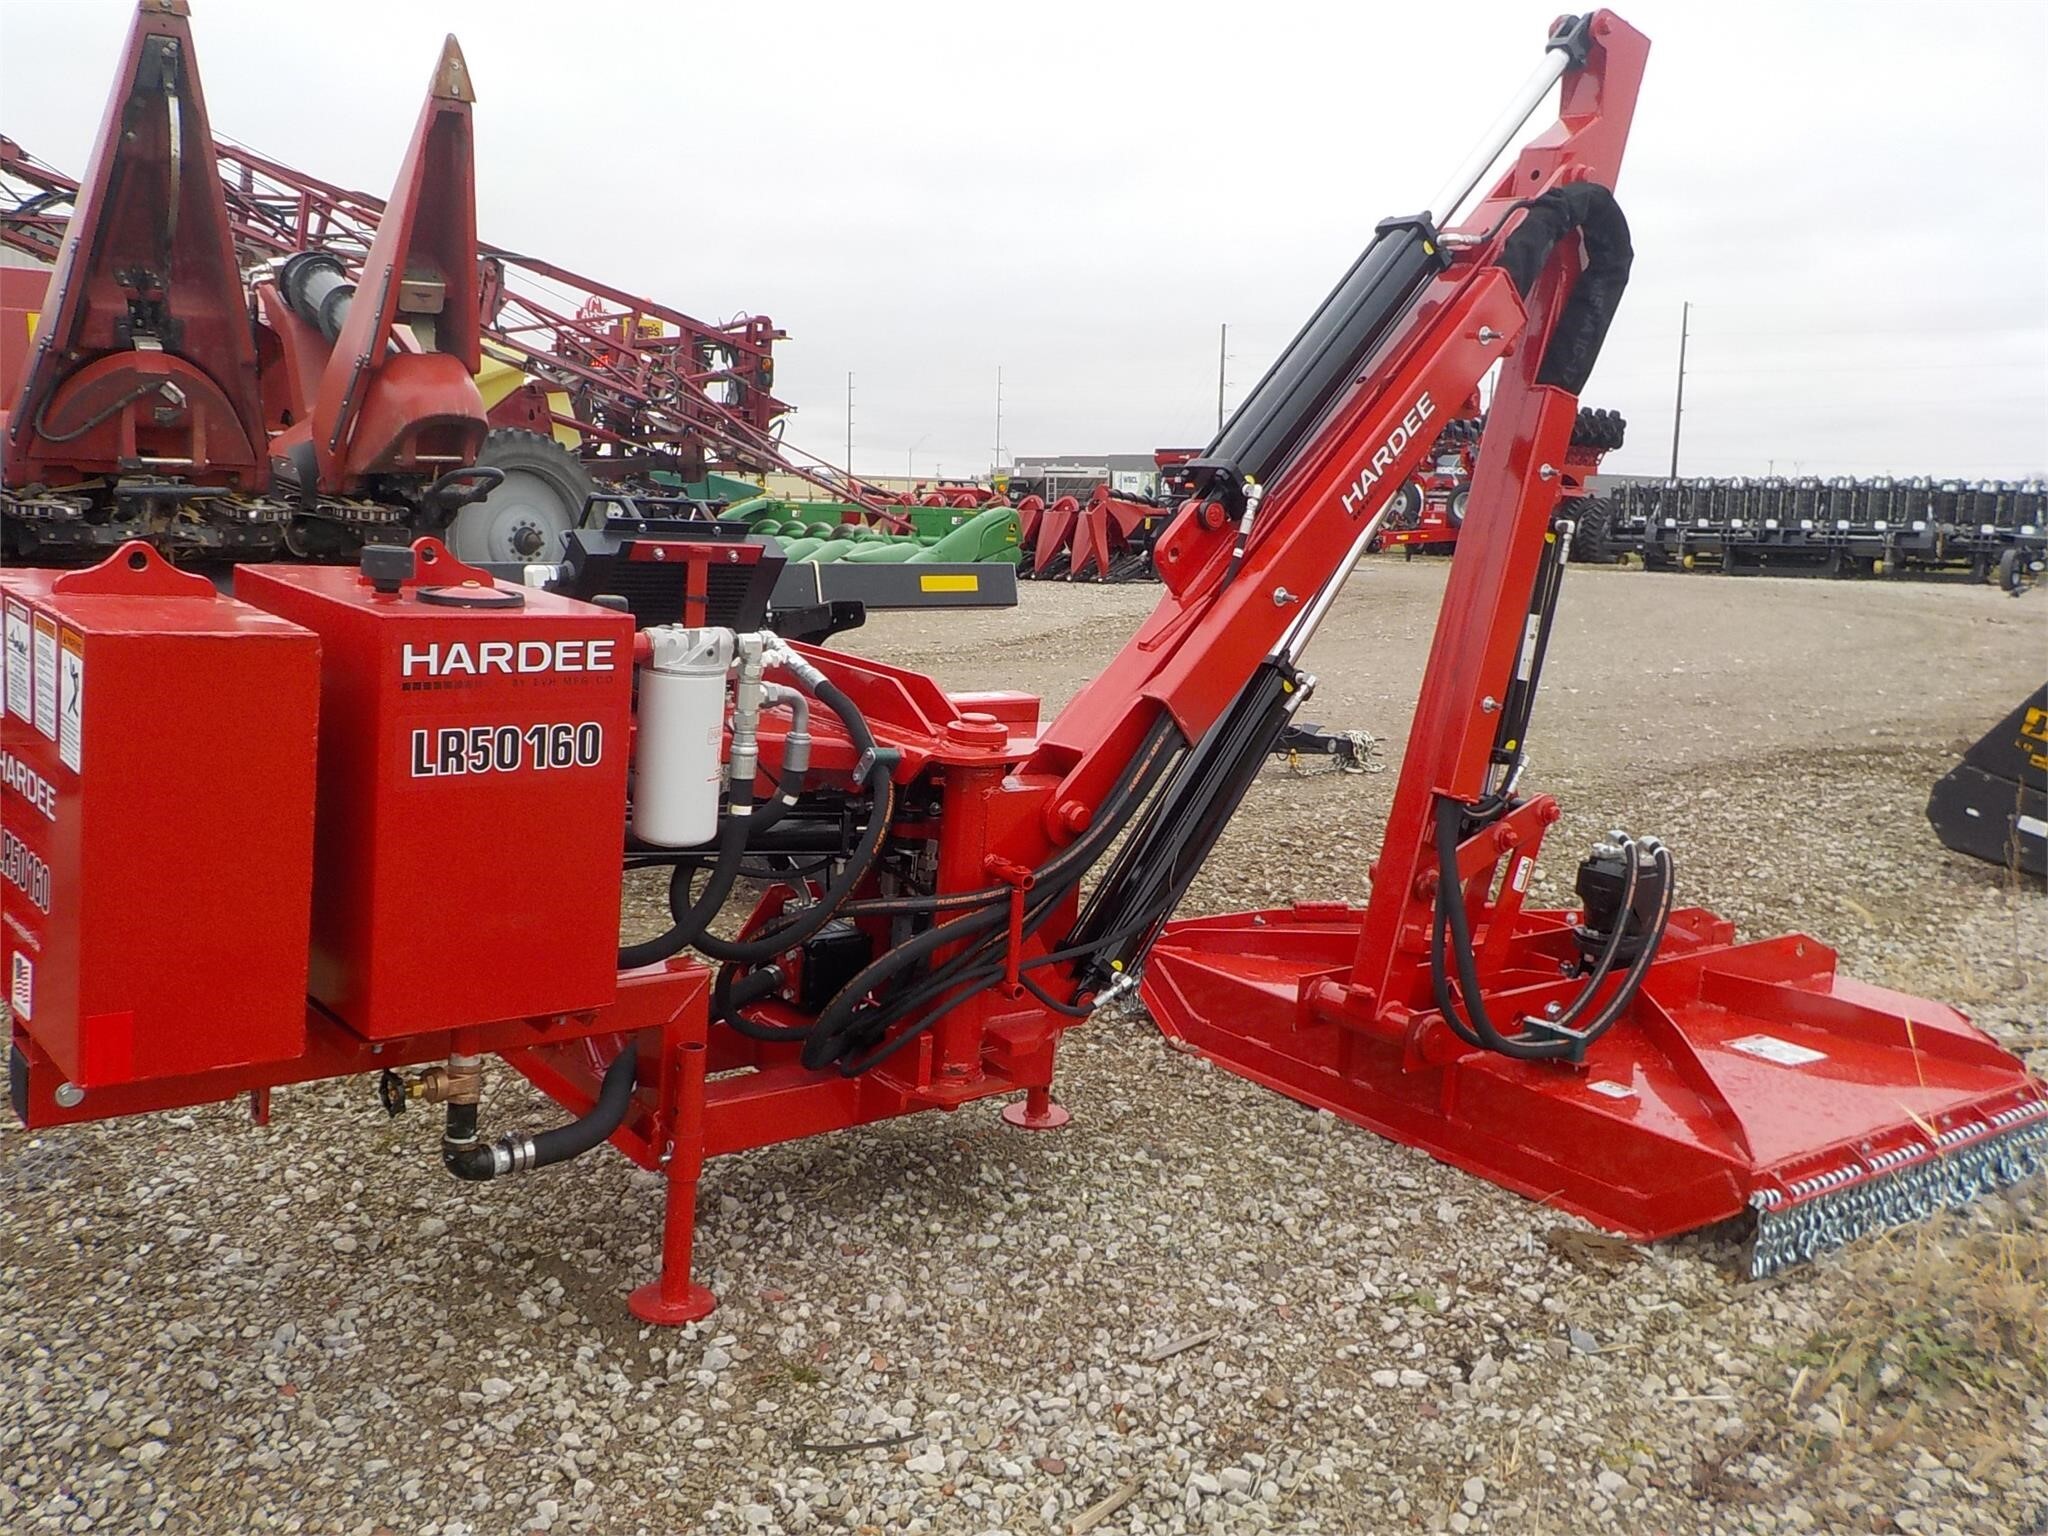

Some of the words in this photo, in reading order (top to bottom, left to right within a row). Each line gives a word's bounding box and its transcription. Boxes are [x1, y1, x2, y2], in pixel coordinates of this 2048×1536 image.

[1341, 391, 1436, 514] HARDEE
[402, 640, 615, 677] HARDEE
[411, 721, 603, 778] LR50160
[0, 751, 56, 822] HARDEE
